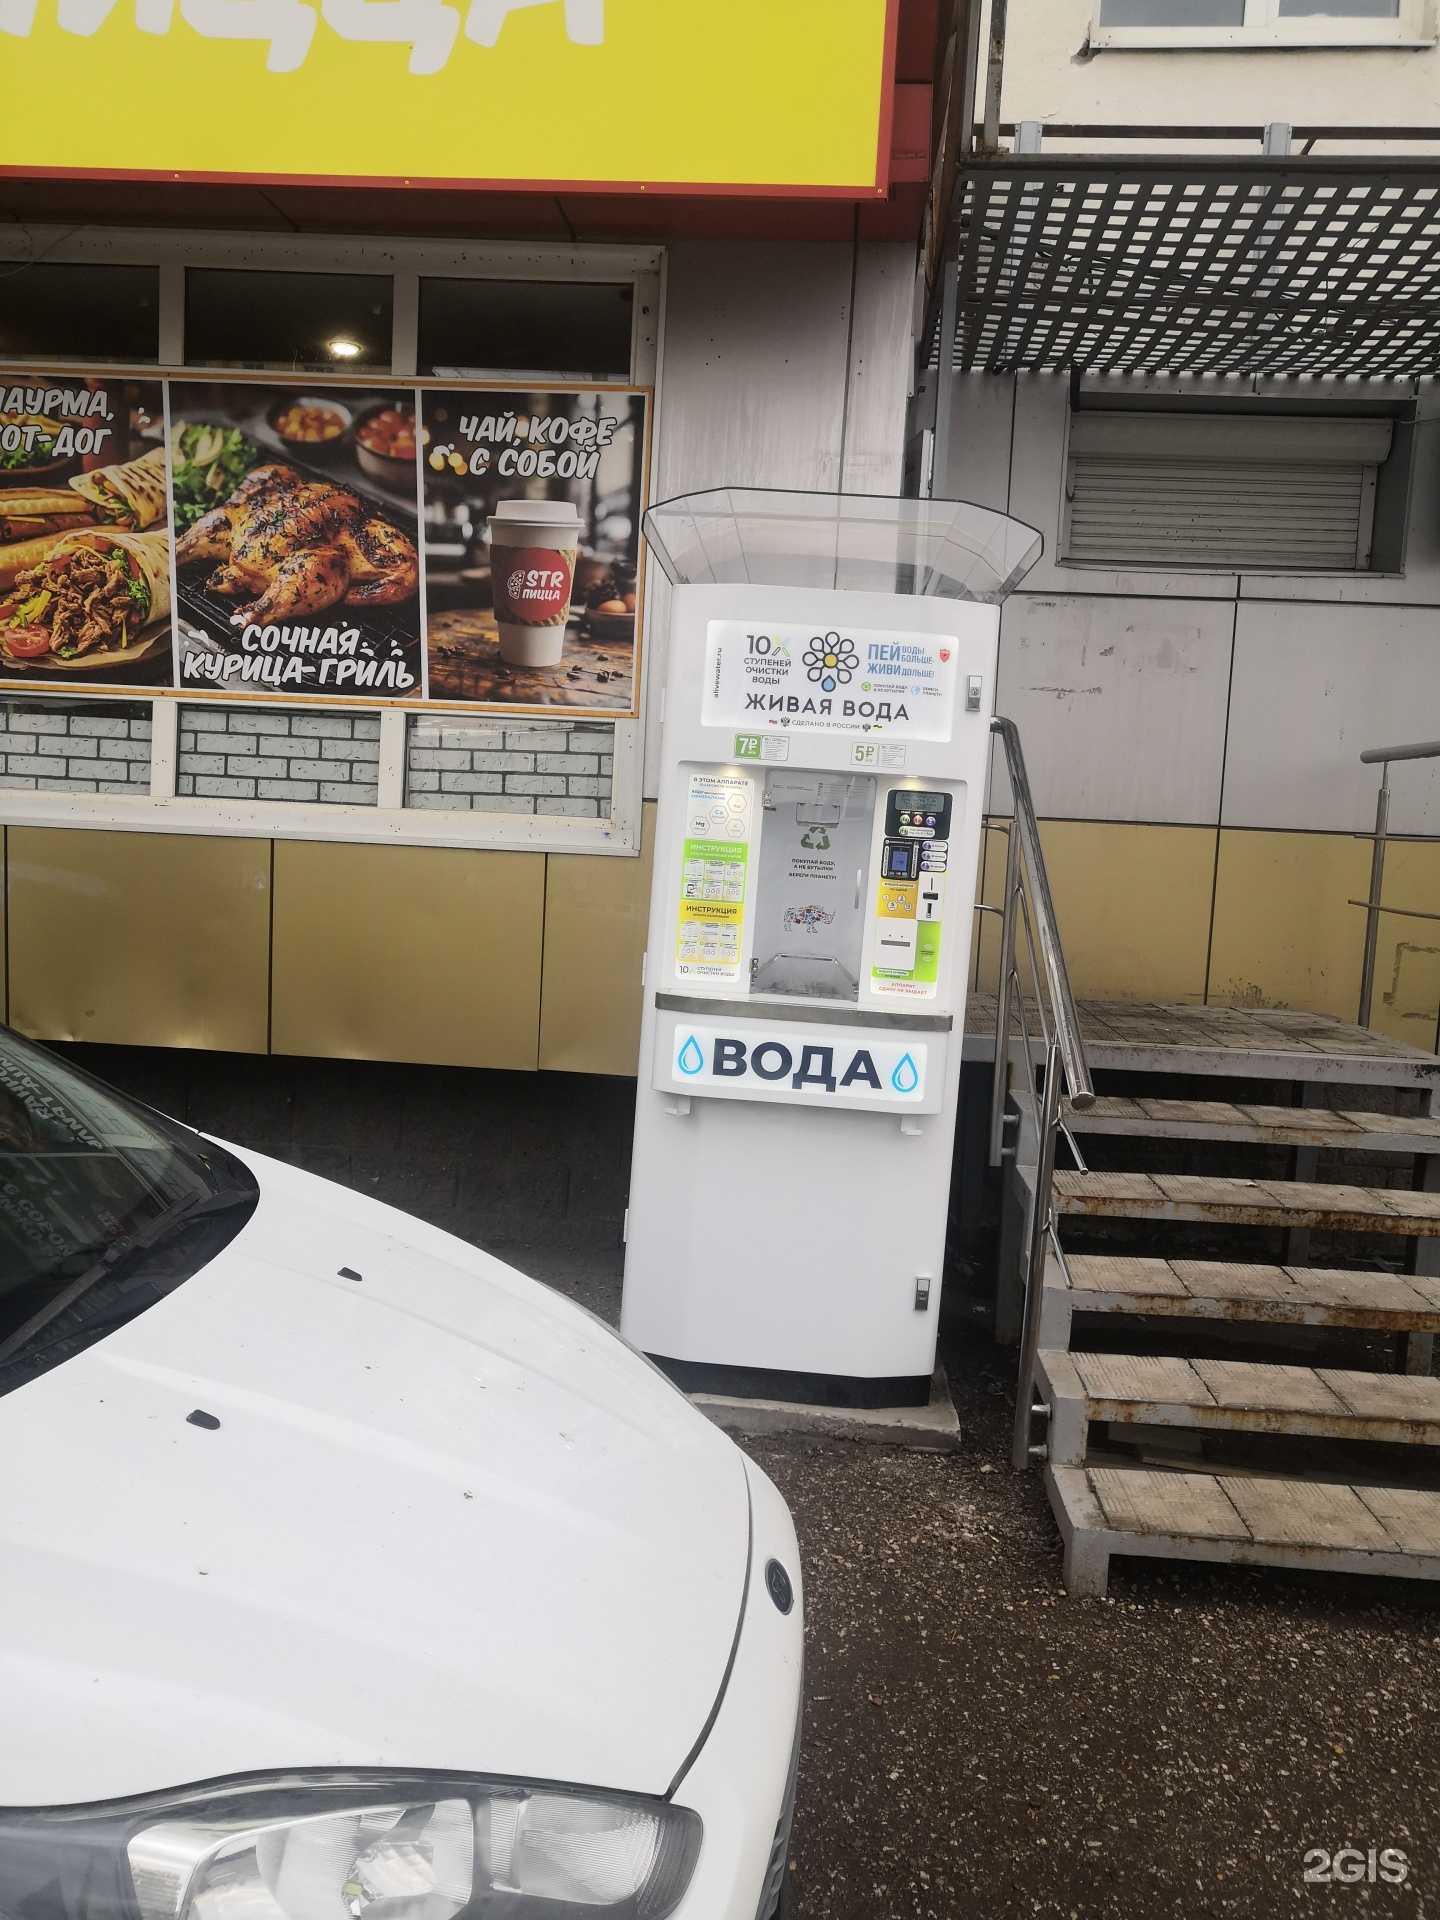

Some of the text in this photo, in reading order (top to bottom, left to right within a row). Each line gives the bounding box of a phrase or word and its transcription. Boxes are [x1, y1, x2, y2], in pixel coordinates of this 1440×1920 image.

[459, 411, 617, 446] ЧАЙ, КОФЕ
[0, 424, 112, 457] ОТ-ДОГ
[470, 445, 600, 479] С СОБОЙ
[526, 570, 564, 588] STR
[522, 589, 560, 601] ПИЦЦА
[241, 624, 360, 656] СОЧНАЯ
[746, 634, 771, 655] 10
[744, 657, 792, 667] СТУПЕНЕЙ
[868, 641, 901, 662] ПЕЙ
[183, 651, 414, 689] КУРИЦА-ГРИЛЬ
[745, 666, 789, 676] ОЧИСТКИ
[866, 663, 901, 676] ЖИВИ
[752, 676, 780, 685] ВОДЫ
[744, 692, 910, 722] ЖИВАЯ ВОДА
[712, 1038, 883, 1093] ВОДА
